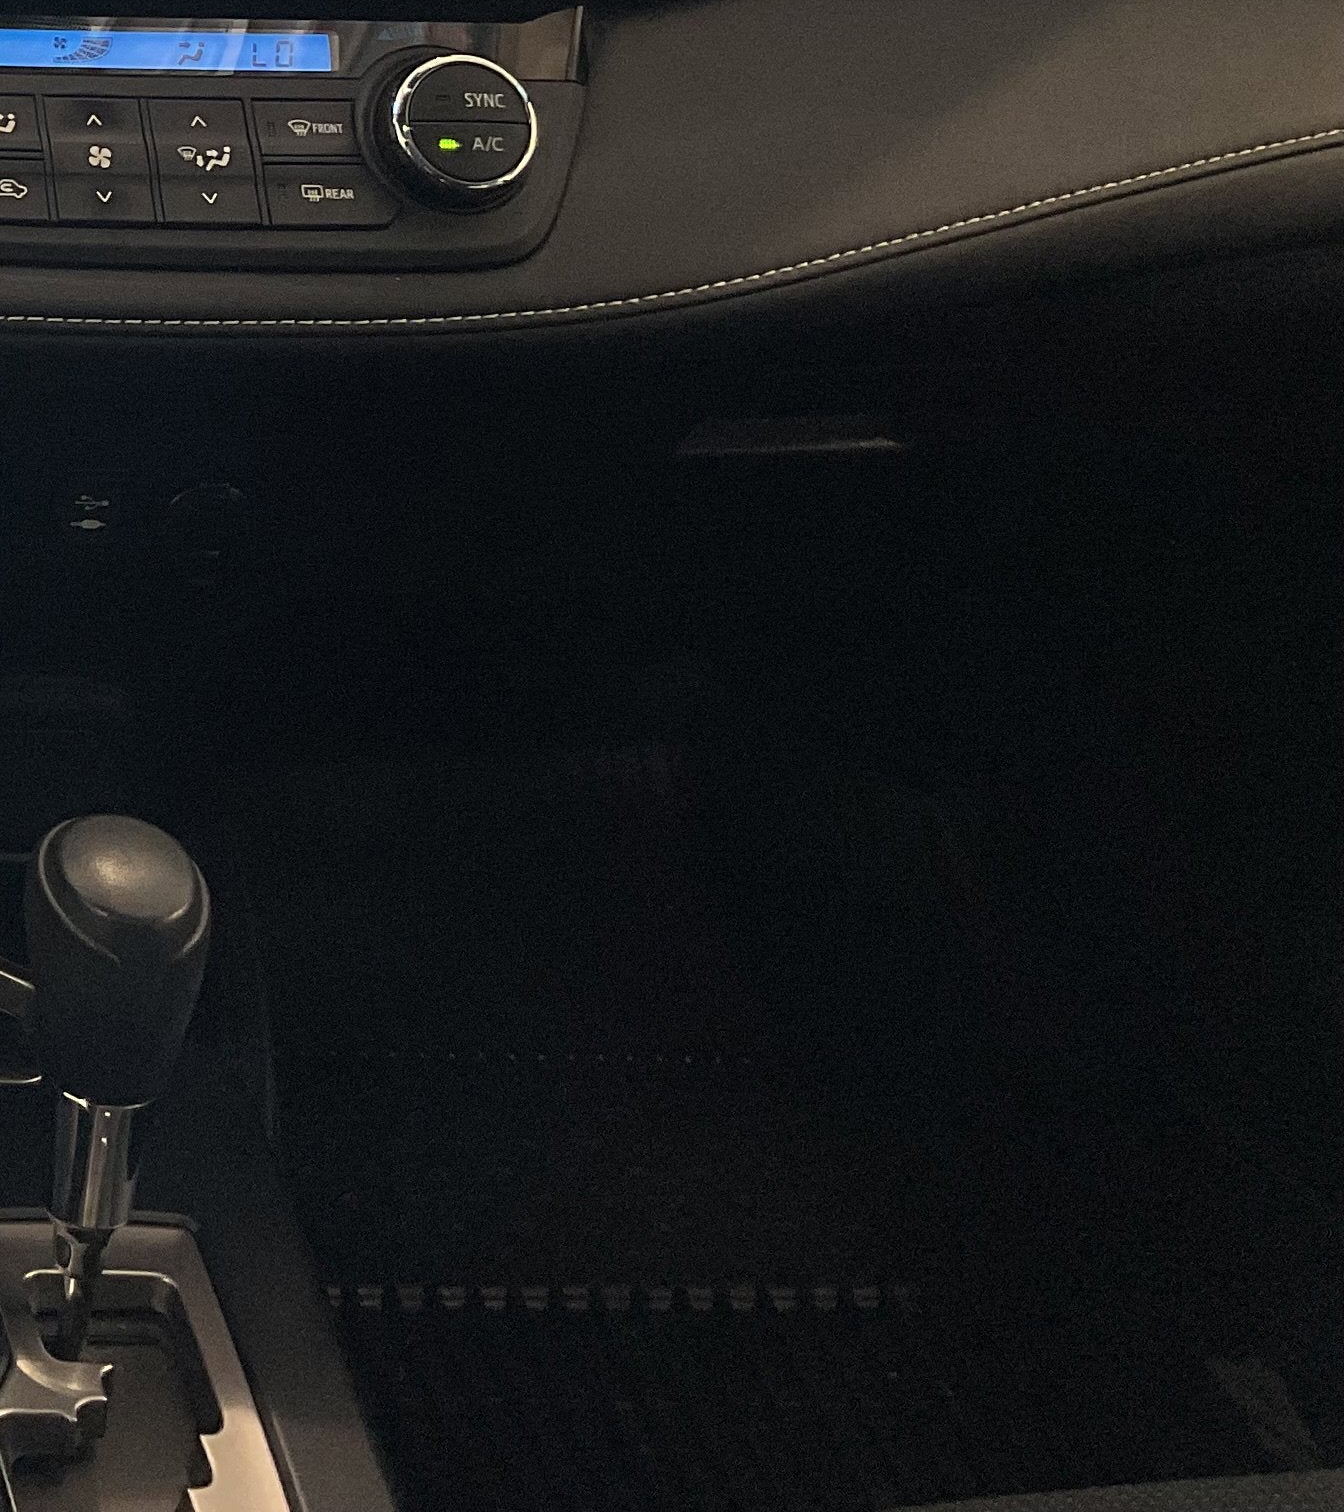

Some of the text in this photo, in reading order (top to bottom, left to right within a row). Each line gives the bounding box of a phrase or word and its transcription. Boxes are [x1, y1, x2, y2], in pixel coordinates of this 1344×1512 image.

[464, 93, 506, 108] SYNC
[313, 123, 343, 134] FRONT
[472, 137, 504, 152] A/C
[325, 188, 354, 200] REAR
